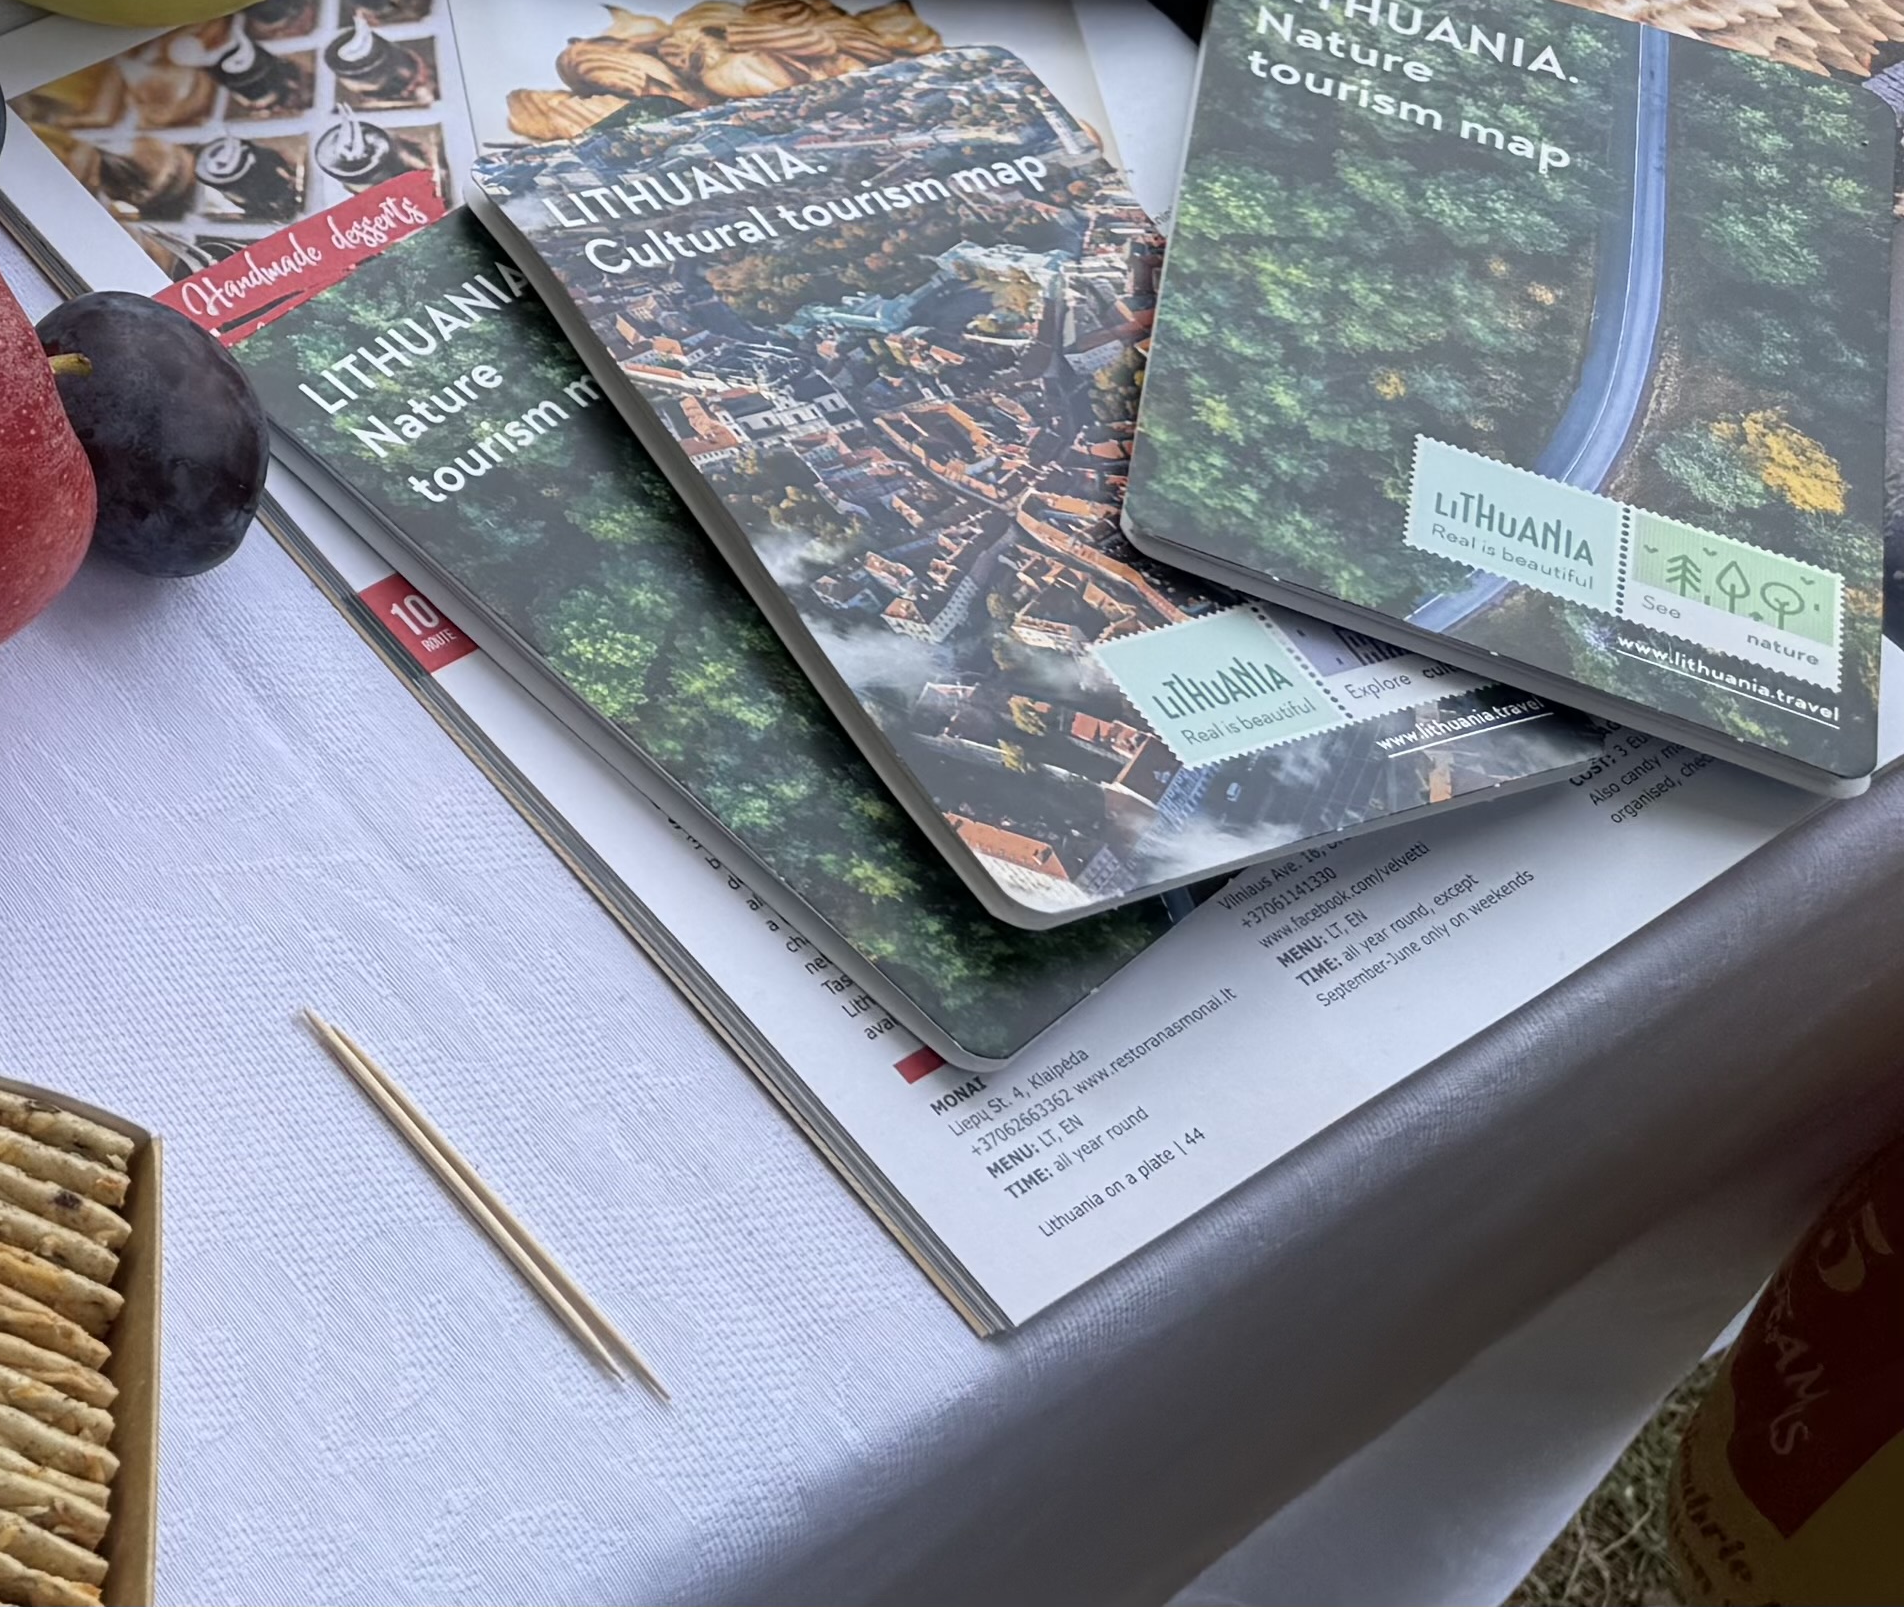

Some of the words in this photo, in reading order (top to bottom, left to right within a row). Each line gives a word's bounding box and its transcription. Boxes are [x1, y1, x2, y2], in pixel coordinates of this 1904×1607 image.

[1254, 6, 1434, 85] Nature
[1247, 46, 1444, 134] tourism
[1458, 113, 1572, 175] map
[542, 147, 829, 231] LITHUANIA.
[581, 210, 781, 276] Cultural
[785, 173, 952, 237] tourism
[950, 149, 1048, 204] map
[179, 230, 323, 323] Handmade
[330, 191, 429, 255] desserts
[353, 358, 505, 459] Nature
[407, 393, 576, 507] tourism
[1428, 522, 1479, 551] Real
[1479, 540, 1498, 557] is
[1499, 546, 1596, 590] beautiful
[389, 593, 440, 637] 10
[422, 627, 459, 653] ROUTE
[1639, 592, 1684, 621] See
[1343, 670, 1414, 703] Explore
[1613, 631, 1843, 723] www.lithuania.travel
[1743, 631, 1821, 667] nature
[1180, 721, 1223, 747] Real
[1219, 714, 1242, 738] is
[1236, 693, 1318, 732] beautiful
[1375, 692, 1545, 752] www.lithuania.travel
[1586, 776, 1622, 808] Also
[1617, 750, 1663, 789] candy
[1608, 771, 1685, 829] organised,
[1215, 871, 1275, 914] Vilniaus
[1268, 852, 1304, 884] Ave.
[1237, 862, 1339, 931] +37061141330
[1255, 835, 1432, 953] www.facebook.com/velvetti
[1274, 929, 1330, 971] MENU:
[1323, 917, 1350, 944] LT,
[1344, 905, 1370, 930] EN
[1293, 951, 1345, 991] TIME:
[1339, 941, 1363, 964] all
[1357, 924, 1392, 955] year
[1386, 897, 1437, 936] round,
[1429, 869, 1481, 911] except
[1314, 935, 1423, 1012] September-June
[1416, 917, 1453, 950] only
[1446, 906, 1471, 930] on
[1462, 863, 1537, 918] weekends
[928, 1072, 990, 1118] MONAI
[967, 1084, 1076, 1161] +37062663362
[1070, 983, 1238, 1097] www.restoranasmonai.lt
[984, 1089, 1014, 1117] St.
[1009, 1080, 1033, 1105] 4,
[1025, 1042, 1092, 1093] Klaipėda
[984, 1137, 1042, 1181] MENU:
[1035, 1123, 1065, 1153] LT,
[1057, 1110, 1086, 1138] EN
[1002, 1160, 1055, 1204] TIME:
[1049, 1149, 1075, 1174] all
[1070, 1131, 1109, 1165] year
[1102, 1102, 1151, 1142] round
[1036, 1187, 1106, 1240] Lithuania
[1102, 1176, 1128, 1201] on
[1134, 1143, 1177, 1181] plate
[1180, 1123, 1207, 1149] 44
